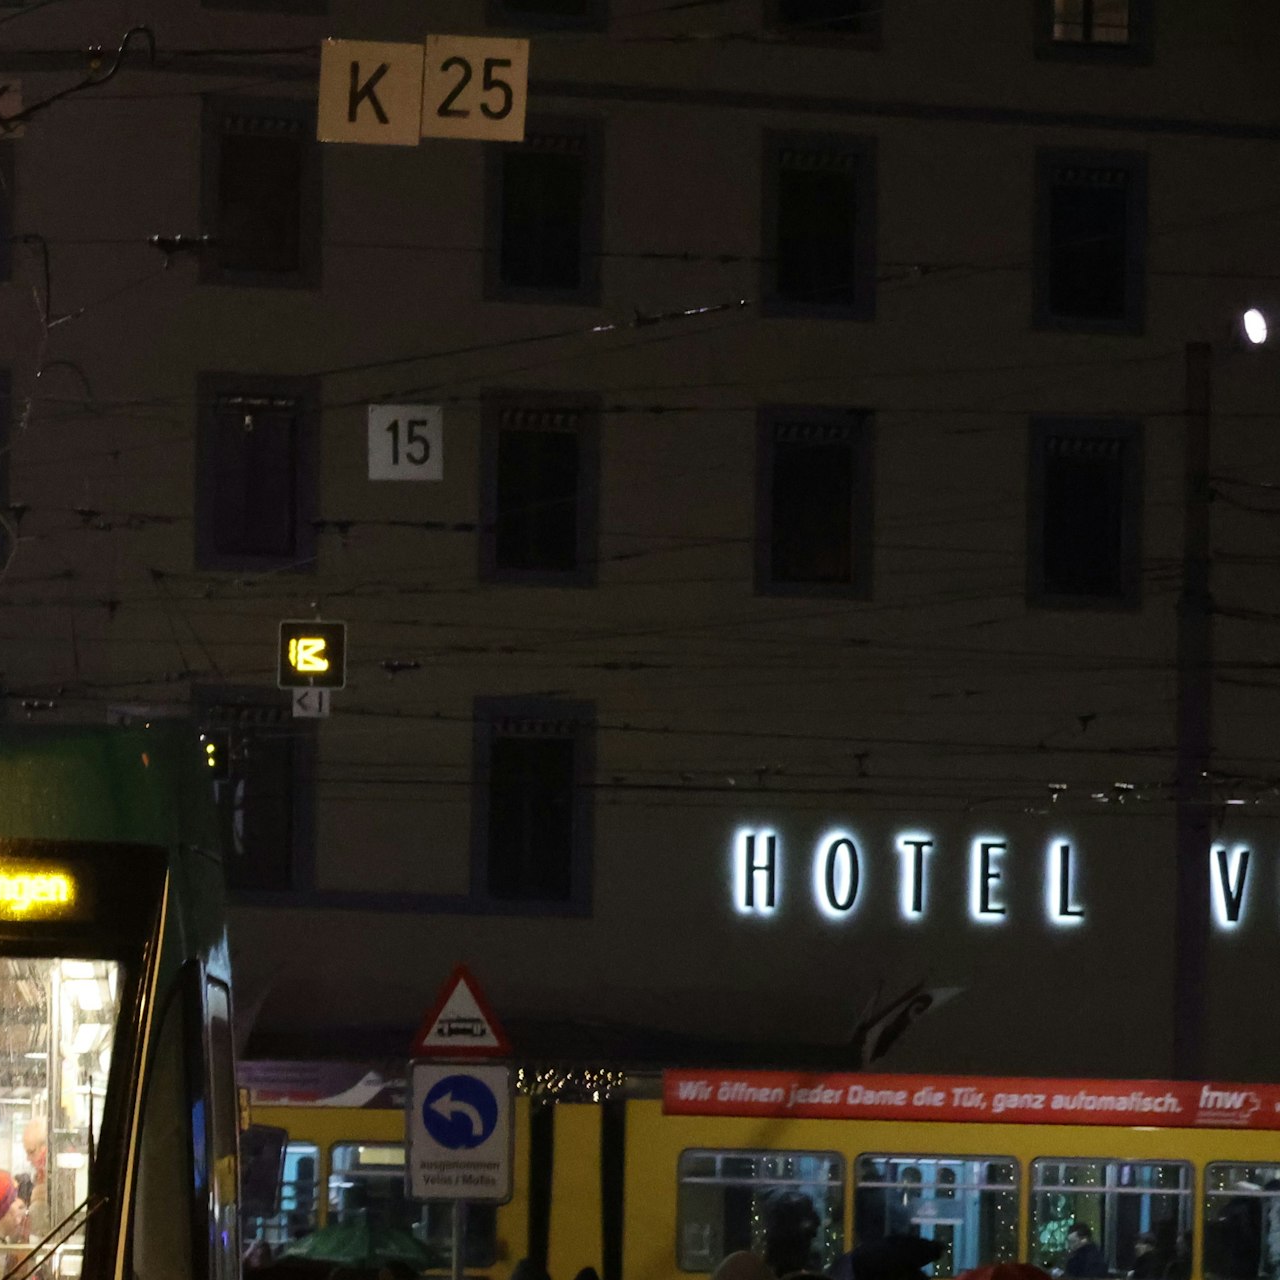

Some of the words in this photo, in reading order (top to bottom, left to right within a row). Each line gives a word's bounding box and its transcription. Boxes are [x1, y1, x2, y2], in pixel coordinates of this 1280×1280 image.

[348, 61, 391, 125] K
[437, 57, 514, 120] 25
[384, 419, 430, 466] 15
[736, 829, 1086, 921] HOTEL
[1212, 840, 1255, 926] V
[678, 1081, 714, 1102] Wir
[717, 1081, 784, 1103] öffnen
[787, 1082, 843, 1108] jeder
[846, 1085, 909, 1107] Dame
[913, 1085, 945, 1108] die
[951, 1087, 987, 1112] Tür,
[991, 1091, 1045, 1113] ganz
[1050, 1088, 1183, 1115] automatisch.
